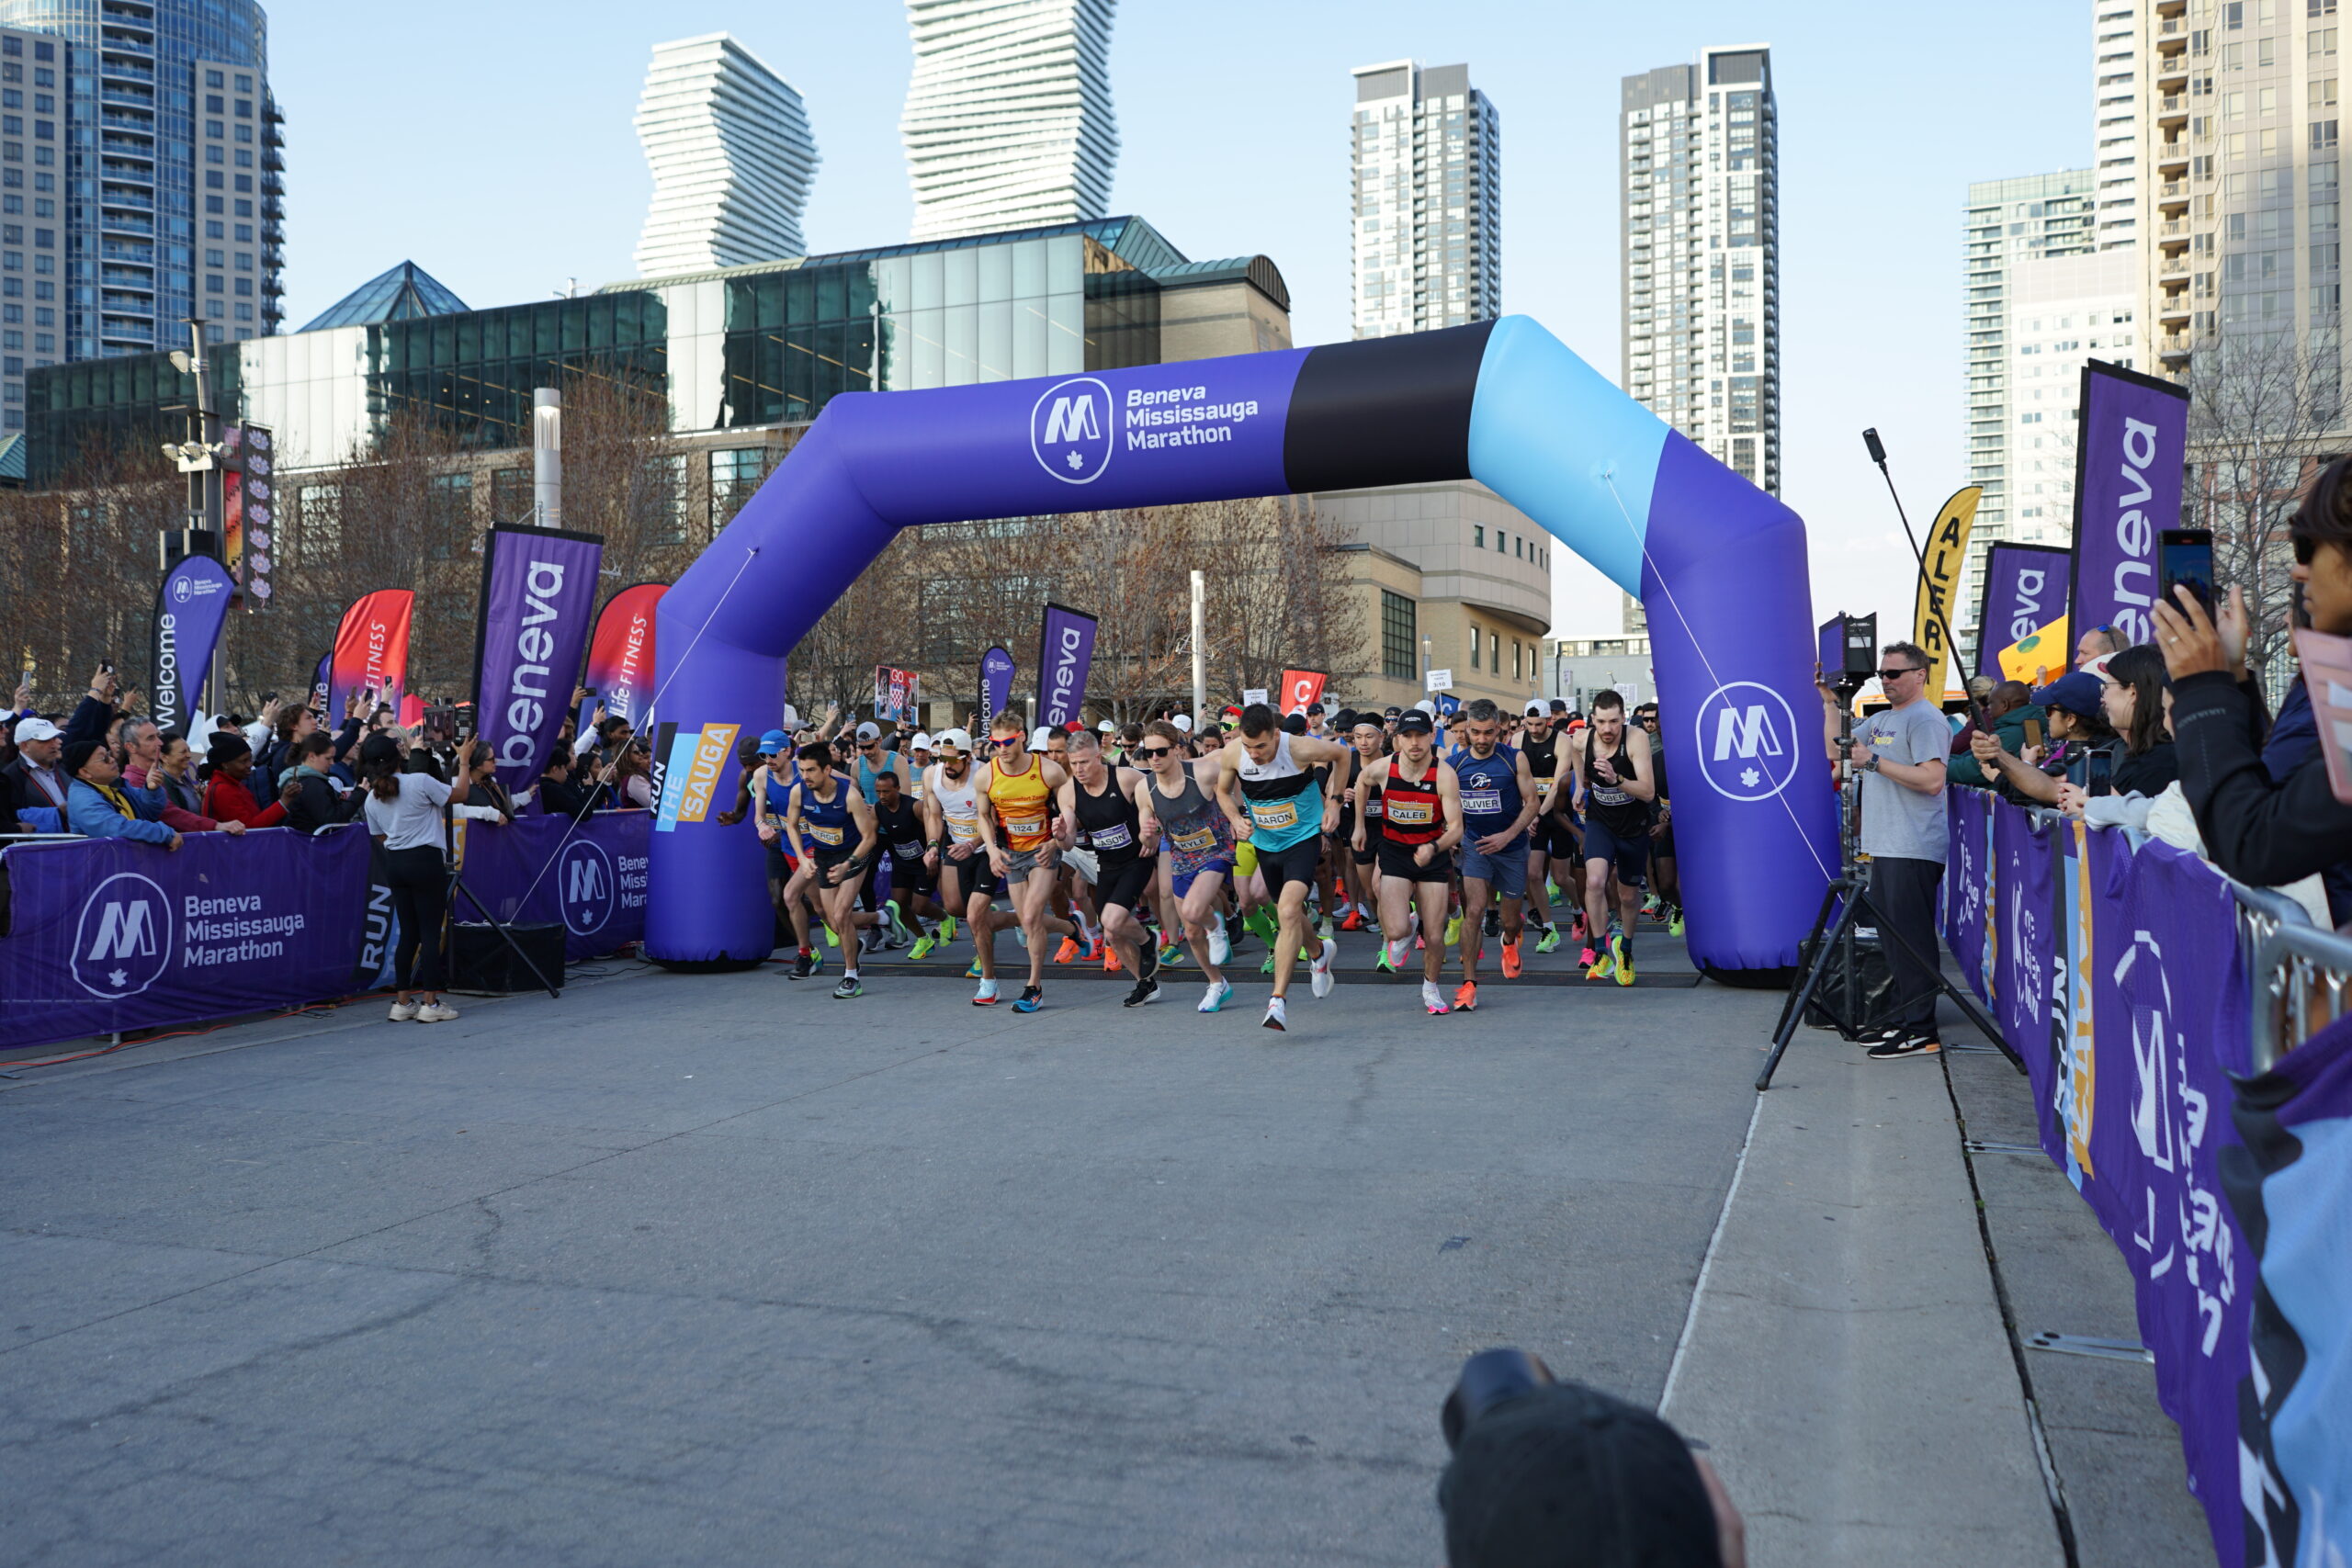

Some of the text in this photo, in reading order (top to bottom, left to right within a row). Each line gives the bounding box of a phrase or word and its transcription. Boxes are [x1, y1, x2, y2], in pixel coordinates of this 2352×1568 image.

[1126, 384, 1206, 407] Beneva
[1125, 400, 1259, 429] Mississauga
[1126, 425, 1232, 451] Marathon
[2111, 416, 2157, 645] eneva
[365, 622, 387, 689] FITNESS
[496, 559, 565, 767] beneva
[618, 615, 648, 685] FITNESS
[1047, 626, 1081, 728] eneva
[650, 761, 666, 816] RUN
[660, 773, 684, 823] THE
[1257, 811, 1294, 825] AARON
[1392, 809, 1427, 819] CALEB
[1463, 798, 1498, 809] OLIVIER
[1097, 833, 1126, 847] JASON
[1180, 836, 1207, 850] KYLE
[185, 893, 263, 919] Beneva
[184, 912, 305, 943] Mississauga
[359, 884, 393, 970] RUN
[183, 939, 285, 968] Marathon
